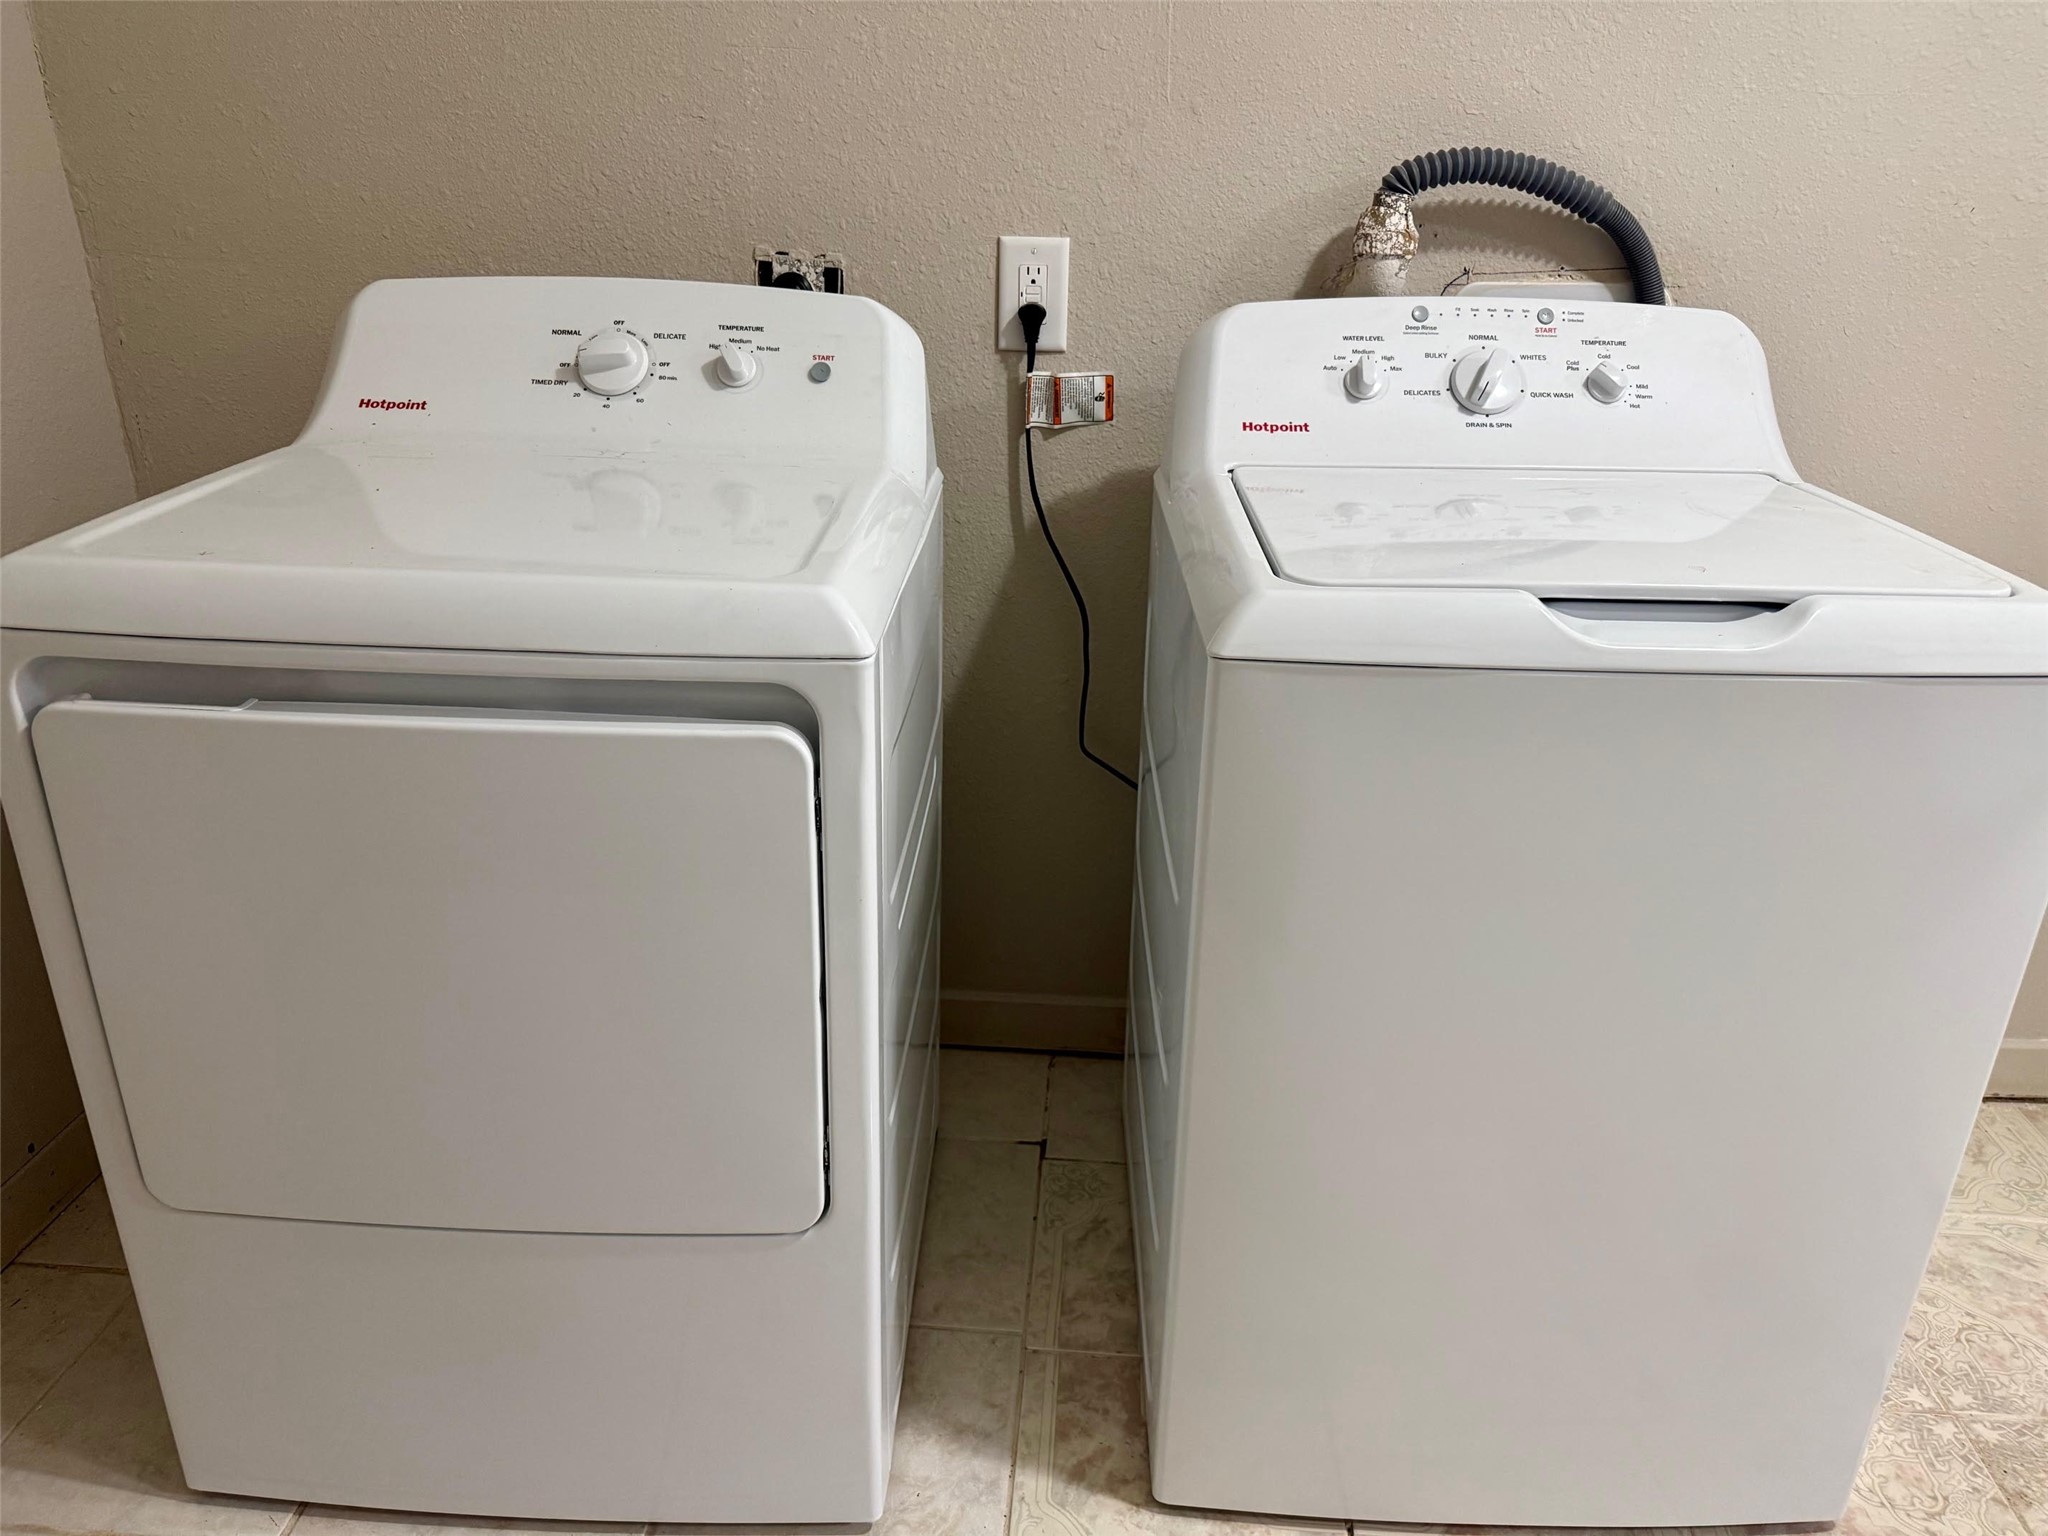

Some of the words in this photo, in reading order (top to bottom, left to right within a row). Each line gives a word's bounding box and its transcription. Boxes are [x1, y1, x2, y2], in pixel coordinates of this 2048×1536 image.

[718, 324, 765, 332] TEMPERATURE
[358, 398, 428, 411] Hotpoint
[1242, 421, 1310, 434] Hotpoint
